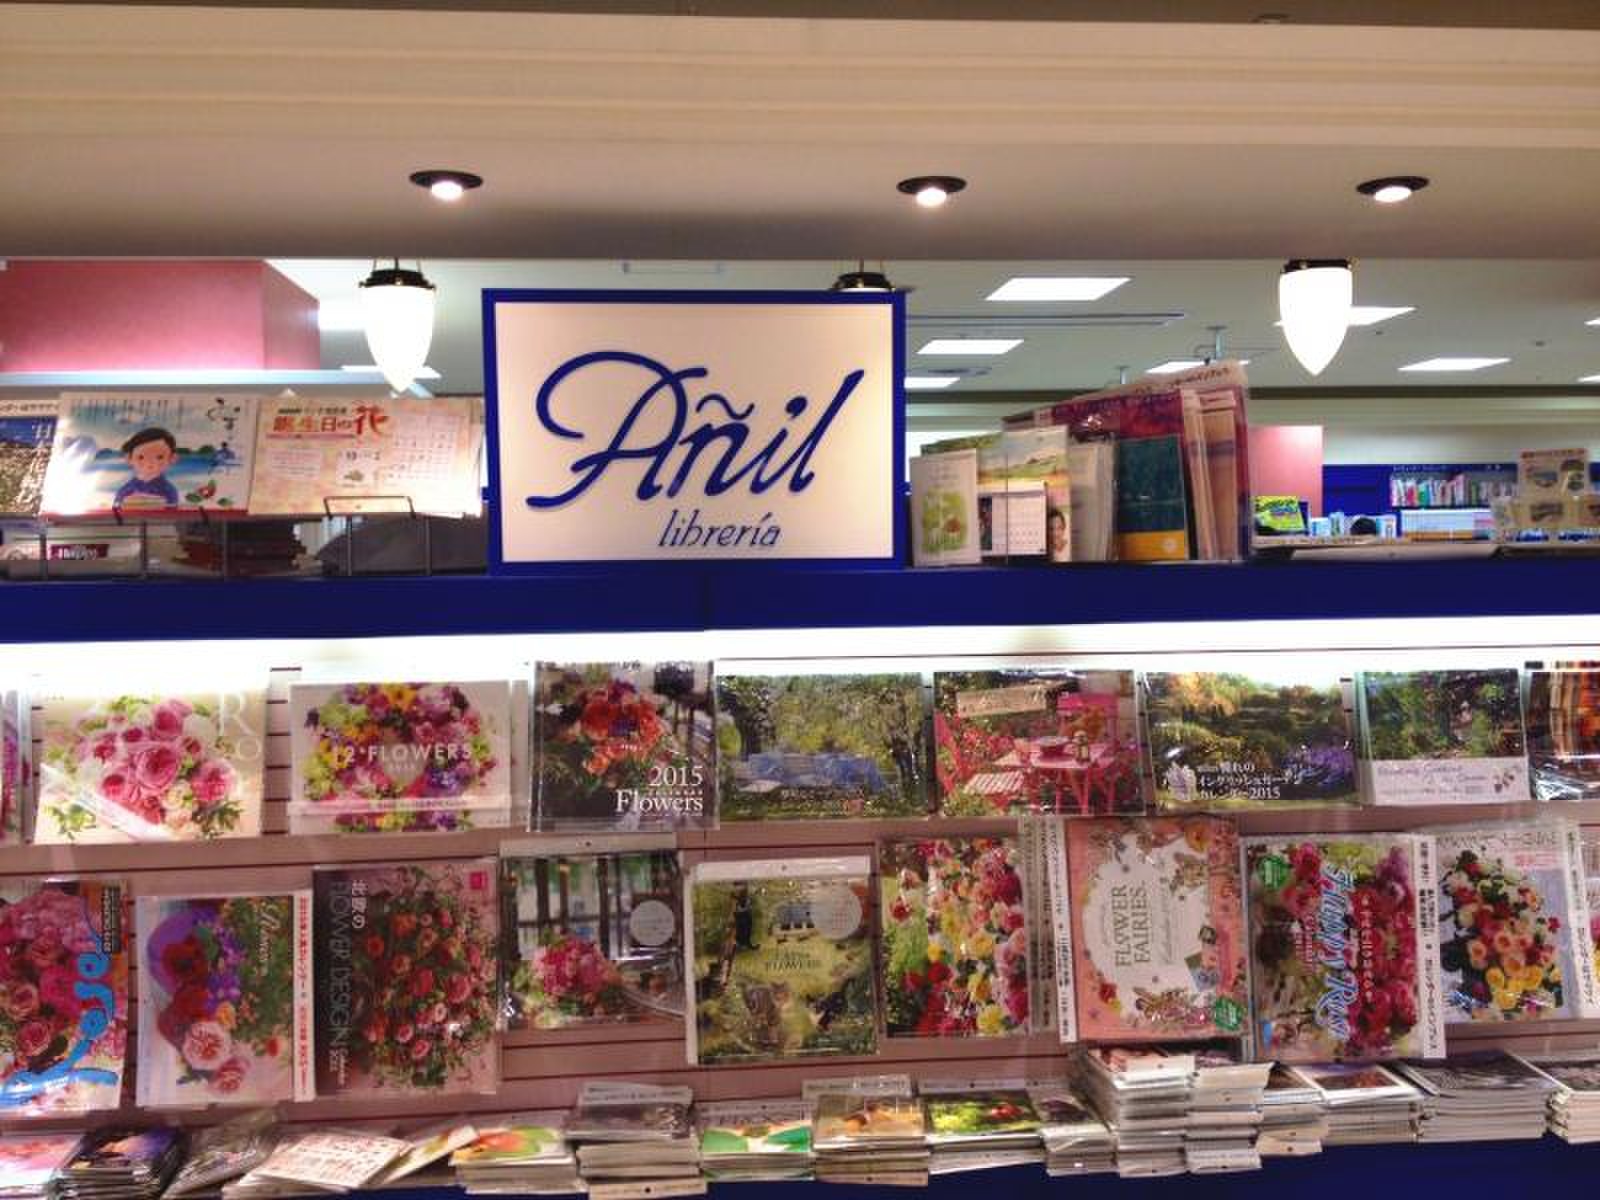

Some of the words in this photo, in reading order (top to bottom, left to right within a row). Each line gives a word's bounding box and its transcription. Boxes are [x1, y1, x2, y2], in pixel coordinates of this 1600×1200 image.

[526, 350, 865, 508] Añil
[657, 509, 781, 547] librería
[367, 743, 472, 763] FLOWERS
[647, 765, 704, 787] 2015
[615, 788, 704, 813] Flowers
[351, 879, 368, 929] 北欧の
[1111, 884, 1132, 967] FLOWER
[1131, 884, 1151, 964] FAIRIES
[329, 967, 351, 1048] DESIGN
